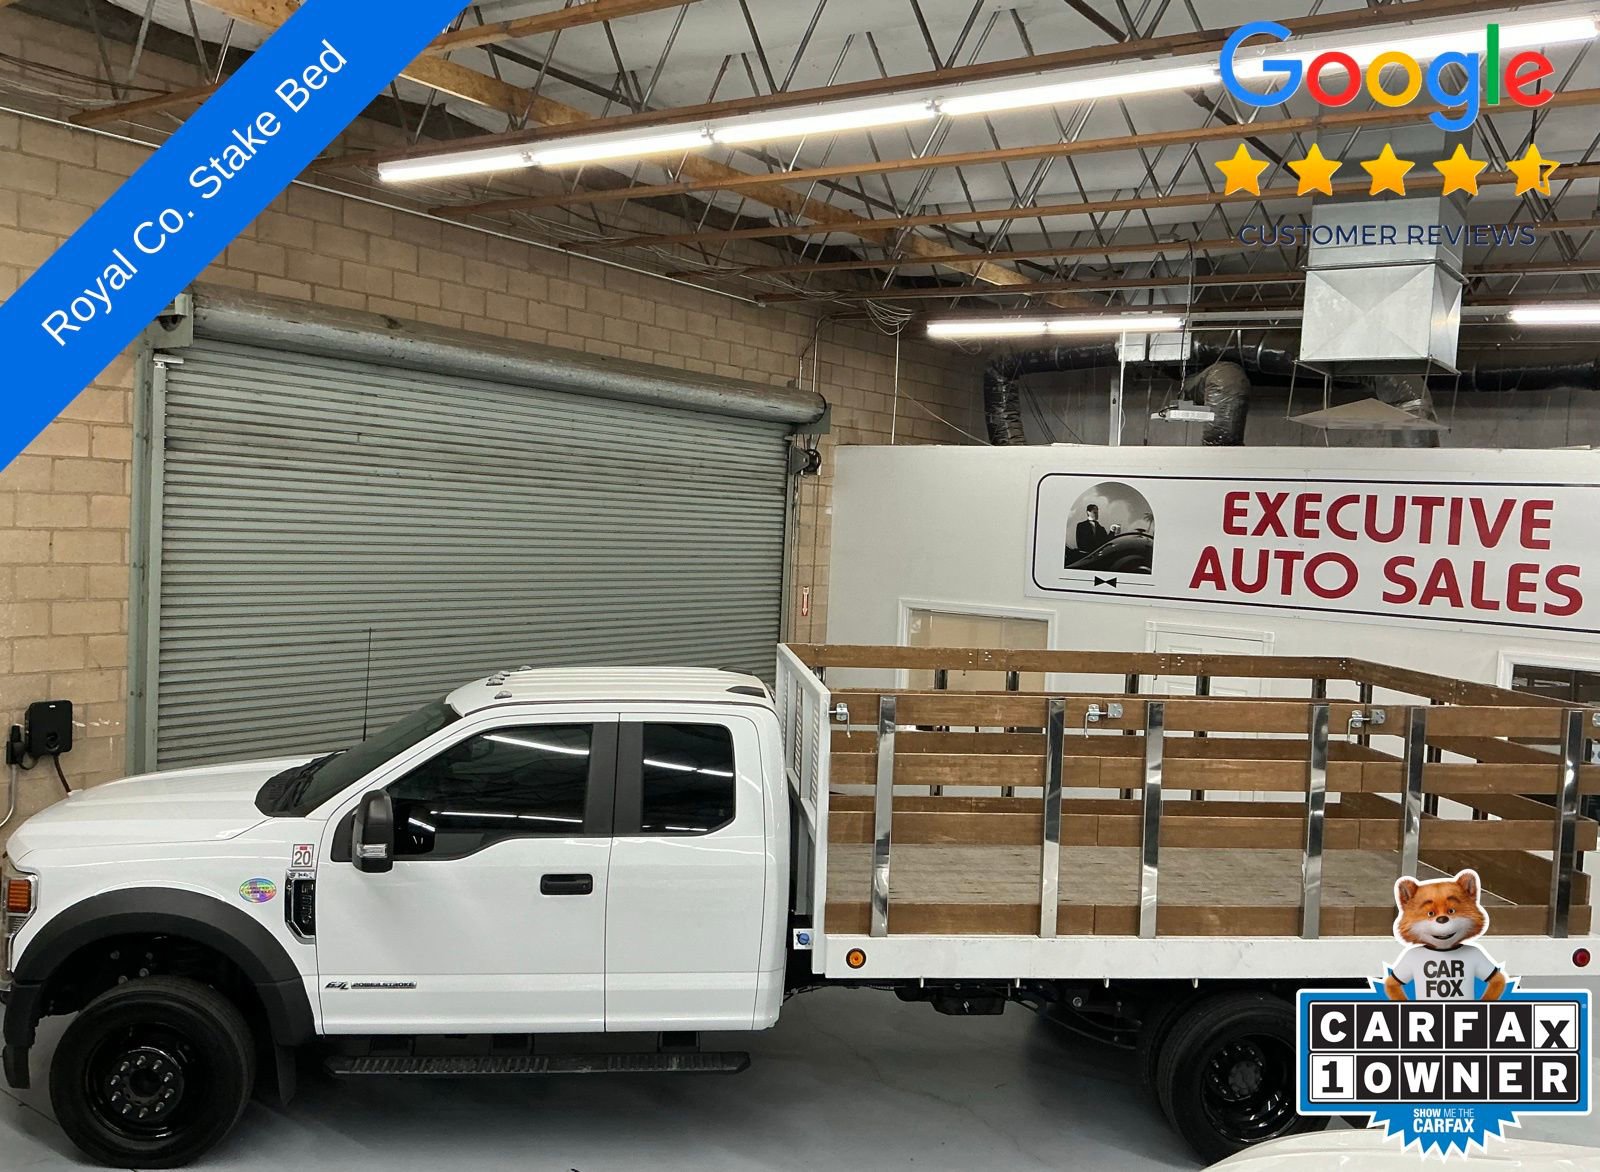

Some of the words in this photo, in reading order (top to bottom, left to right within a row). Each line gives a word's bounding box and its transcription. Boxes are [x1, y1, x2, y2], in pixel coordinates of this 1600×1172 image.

[1223, 491, 1553, 550] EXECUTIVE
[1189, 546, 1358, 599] AUTO
[1383, 556, 1583, 616] SALES
[294, 850, 311, 866] 20
